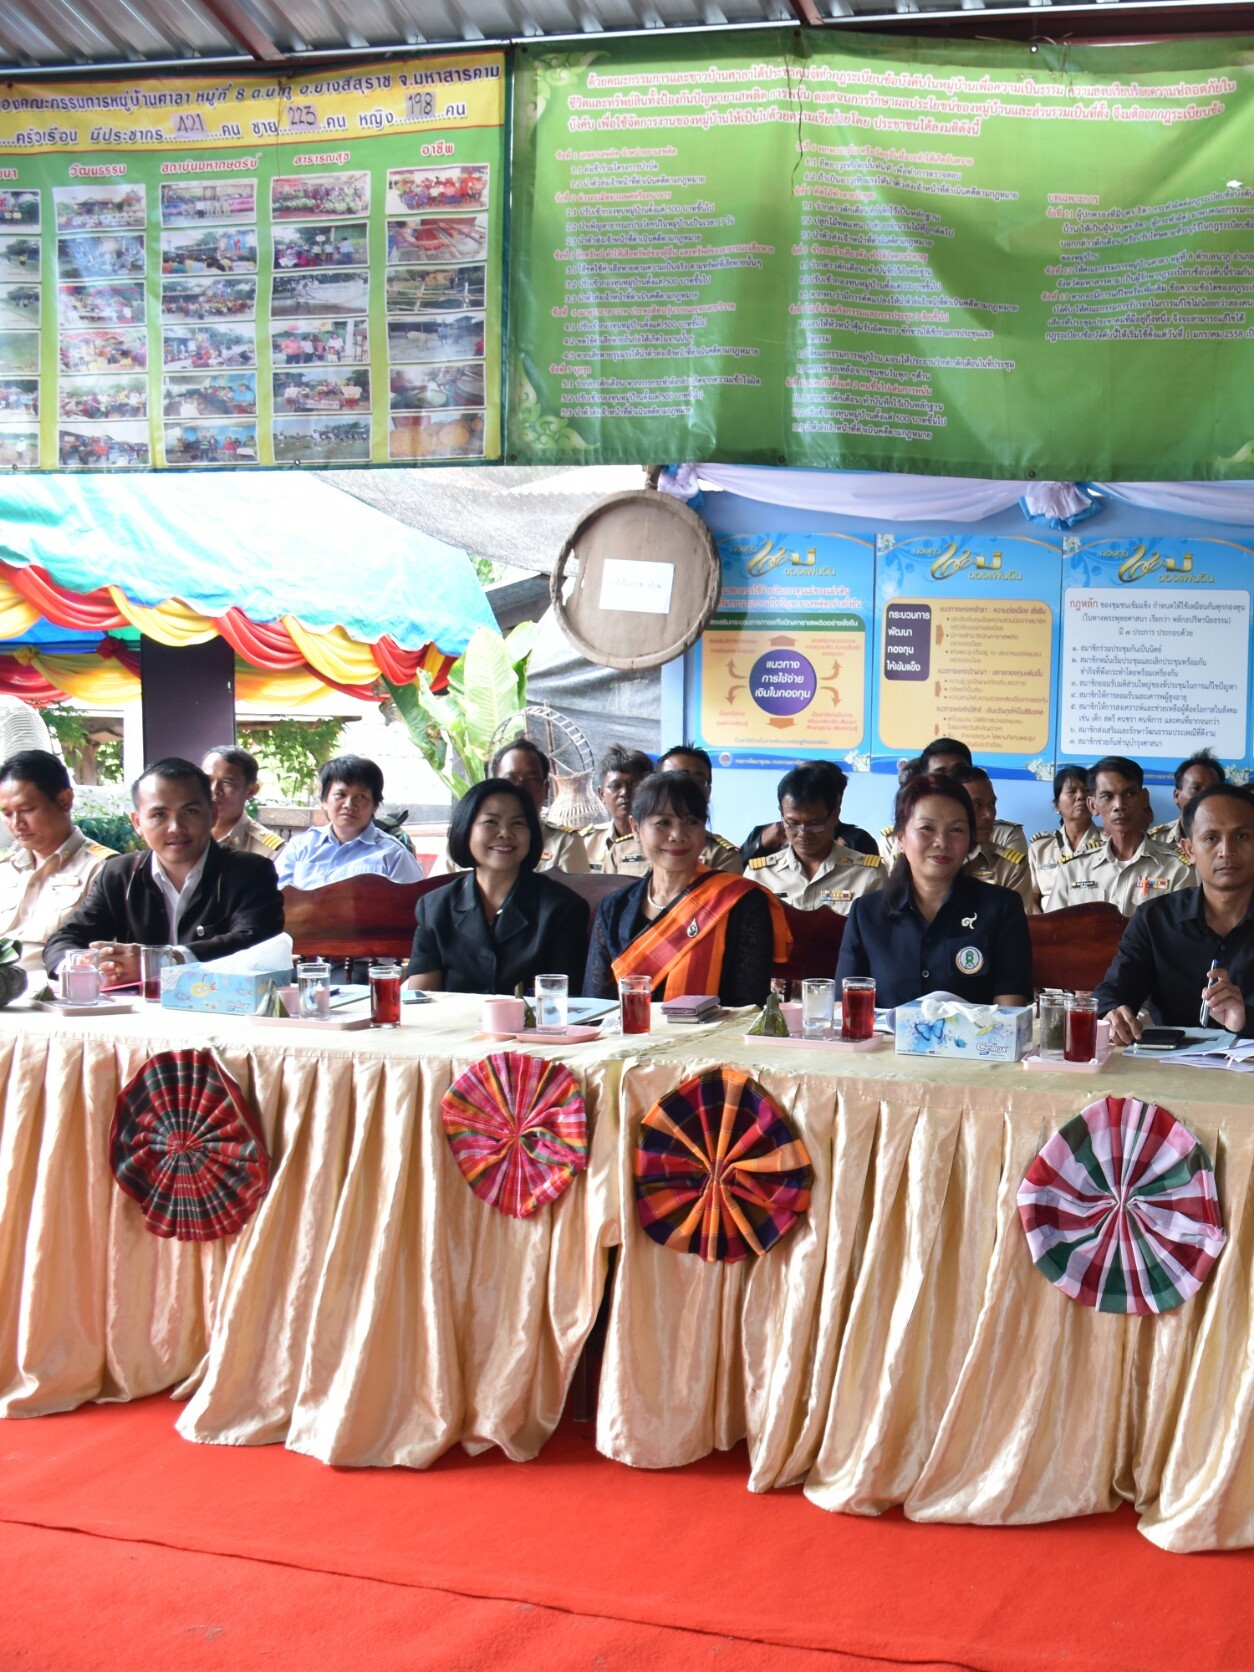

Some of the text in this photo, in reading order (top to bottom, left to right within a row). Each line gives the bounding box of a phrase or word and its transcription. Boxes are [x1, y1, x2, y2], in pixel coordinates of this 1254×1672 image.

[196, 84, 232, 107] หมู่ที่
[236, 89, 245, 100] 8
[300, 75, 391, 95] อ.ยางสีสุราช
[399, 65, 500, 86] จ.มหาสารคาม
[223, 123, 240, 136] คน
[289, 105, 317, 125] 223
[326, 116, 346, 128] คน
[359, 109, 394, 128] หญิง
[408, 93, 432, 115] 198
[446, 103, 466, 116] คน
[70, 162, 126, 176] วัฒนธรรม
[421, 142, 454, 156] อาชีพ
[896, 414, 909, 423] 500
[1070, 598, 1098, 611] กฎหลัก
[889, 611, 930, 620] กระบวนการ
[888, 627, 912, 636] พัฒนา
[888, 646, 914, 655] กองทุน
[766, 660, 800, 669] แนวทาง
[887, 660, 921, 671] ให้เข้มแข็ง
[762, 673, 804, 685] การใช้จ่าย
[755, 687, 810, 700] เงินในกองทุน
[976, 1043, 1007, 1053] Cellox
